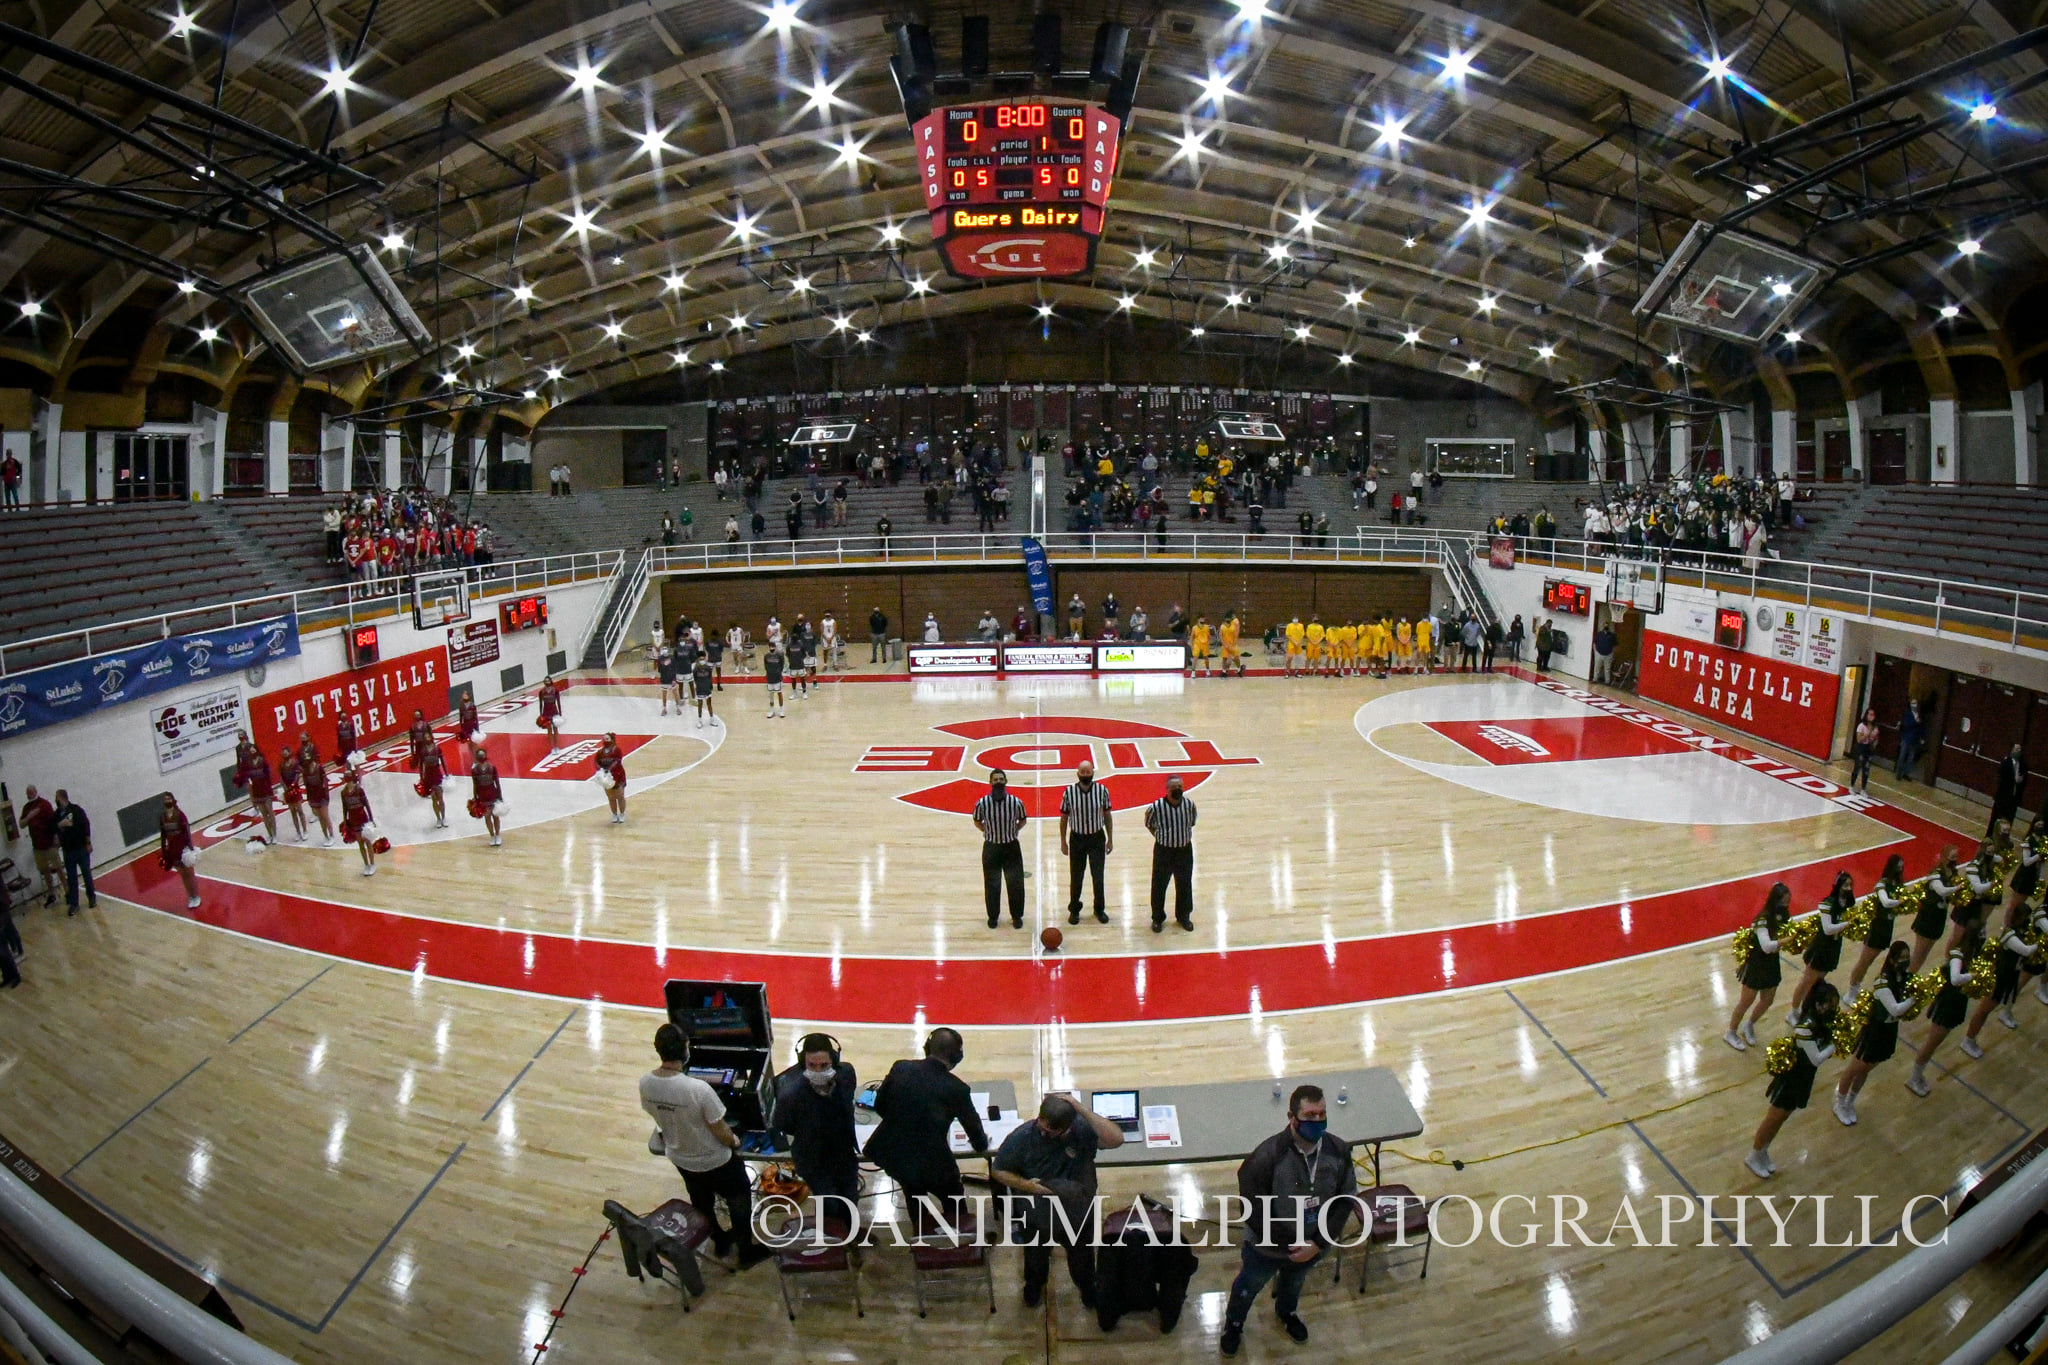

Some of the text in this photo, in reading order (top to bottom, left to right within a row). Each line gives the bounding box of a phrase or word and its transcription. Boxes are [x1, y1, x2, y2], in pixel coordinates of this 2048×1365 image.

[949, 110, 973, 120] Home
[996, 105, 1045, 127] 8:00
[963, 120, 978, 142] 0
[1069, 118, 1084, 139] 0
[1000, 140, 1028, 151] period
[947, 157, 968, 167] fouls
[1000, 155, 1028, 165] player
[1061, 154, 1081, 164] fouls
[953, 169, 988, 187] 0 5
[1040, 168, 1079, 185] 5 0
[949, 192, 966, 200] won
[1003, 190, 1025, 199] game
[1062, 189, 1080, 197] won
[953, 208, 1080, 228] Guers Dairy
[1721, 613, 1742, 630] 8:00
[1786, 611, 1795, 624] 16
[1821, 618, 1830, 631] 16
[356, 630, 376, 647] 8:00
[1653, 642, 1814, 708] POTTSVILLE
[273, 660, 436, 733] POTTSVILLE
[1693, 683, 1754, 722] AREA
[190, 700, 240, 720] WRESTLING
[198, 710, 235, 728] CHAMPS
[1538, 682, 1733, 750] CRIMSON
[155, 714, 187, 732] TIDE
[350, 703, 397, 738] REA
[1740, 753, 1886, 812] TIDE
